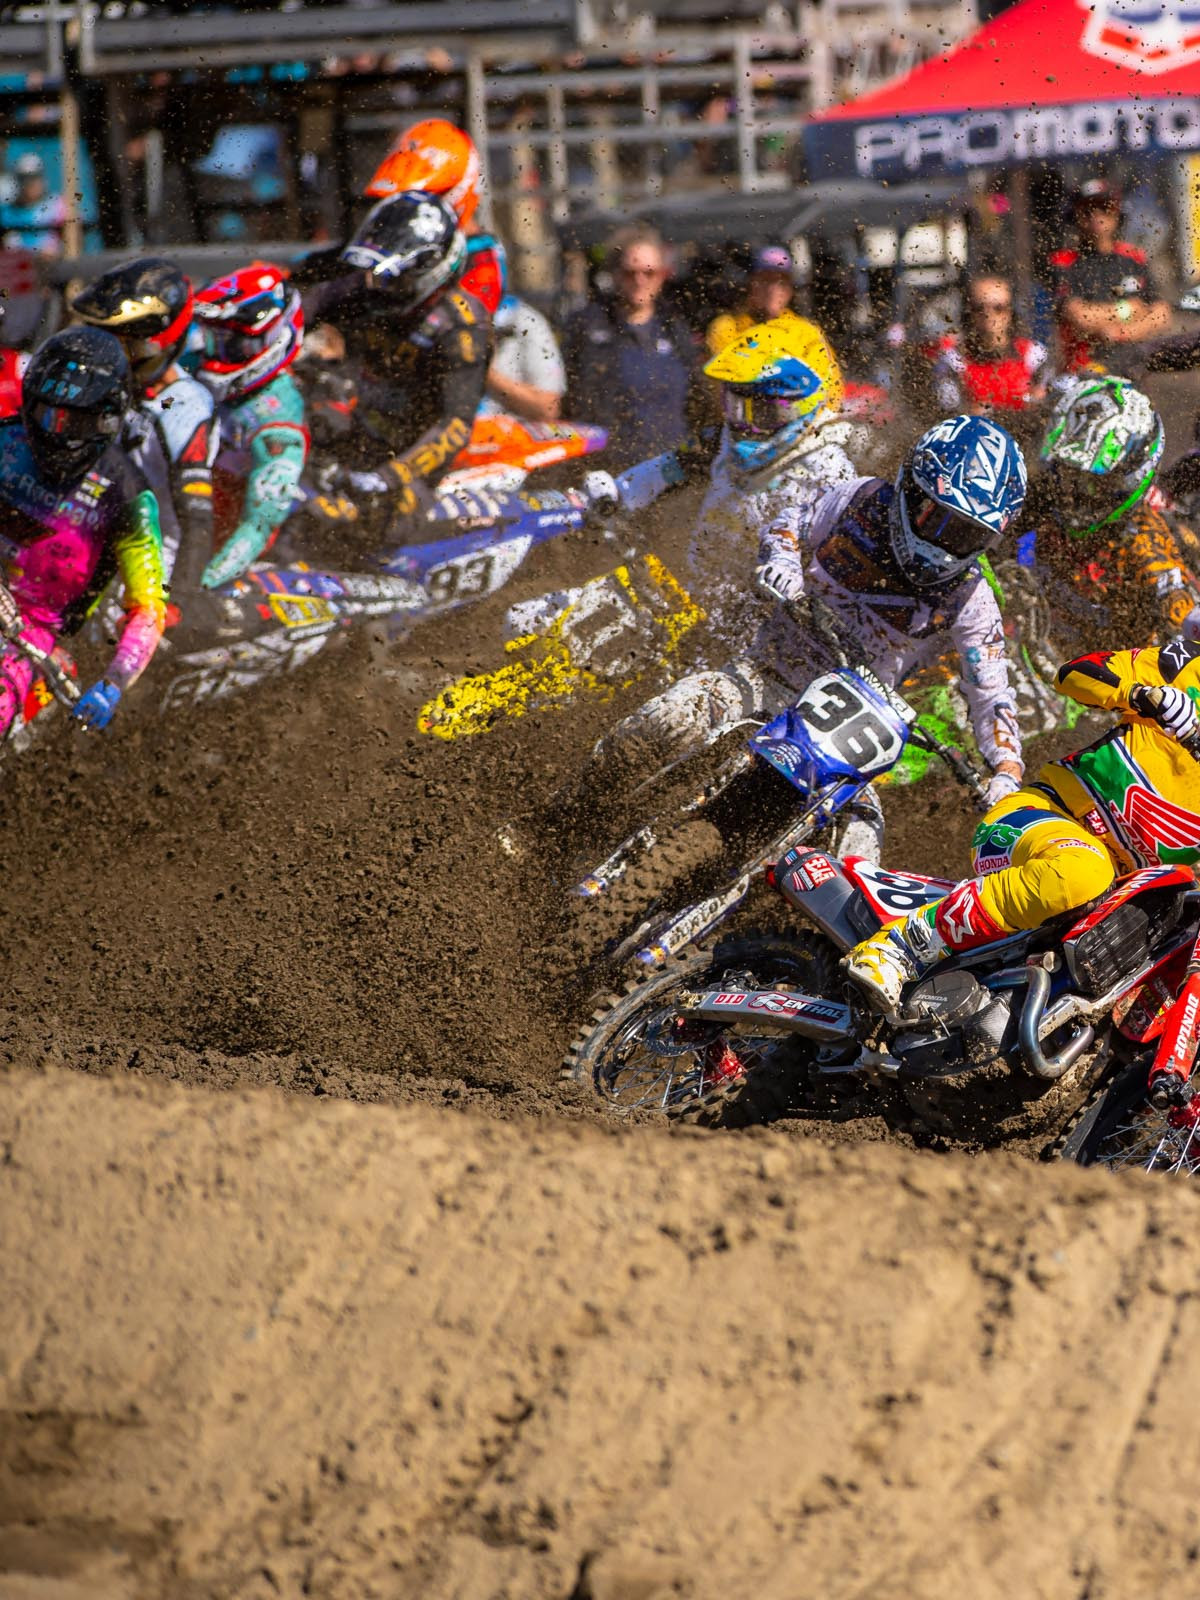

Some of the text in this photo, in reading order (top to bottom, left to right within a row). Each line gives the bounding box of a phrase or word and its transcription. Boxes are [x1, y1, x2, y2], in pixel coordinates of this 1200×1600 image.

[799, 681, 896, 769] 36
[978, 856, 1010, 872] HONDA
[715, 993, 845, 1019] DID RENTHAL
[1175, 993, 1200, 1060] DUNLOP
